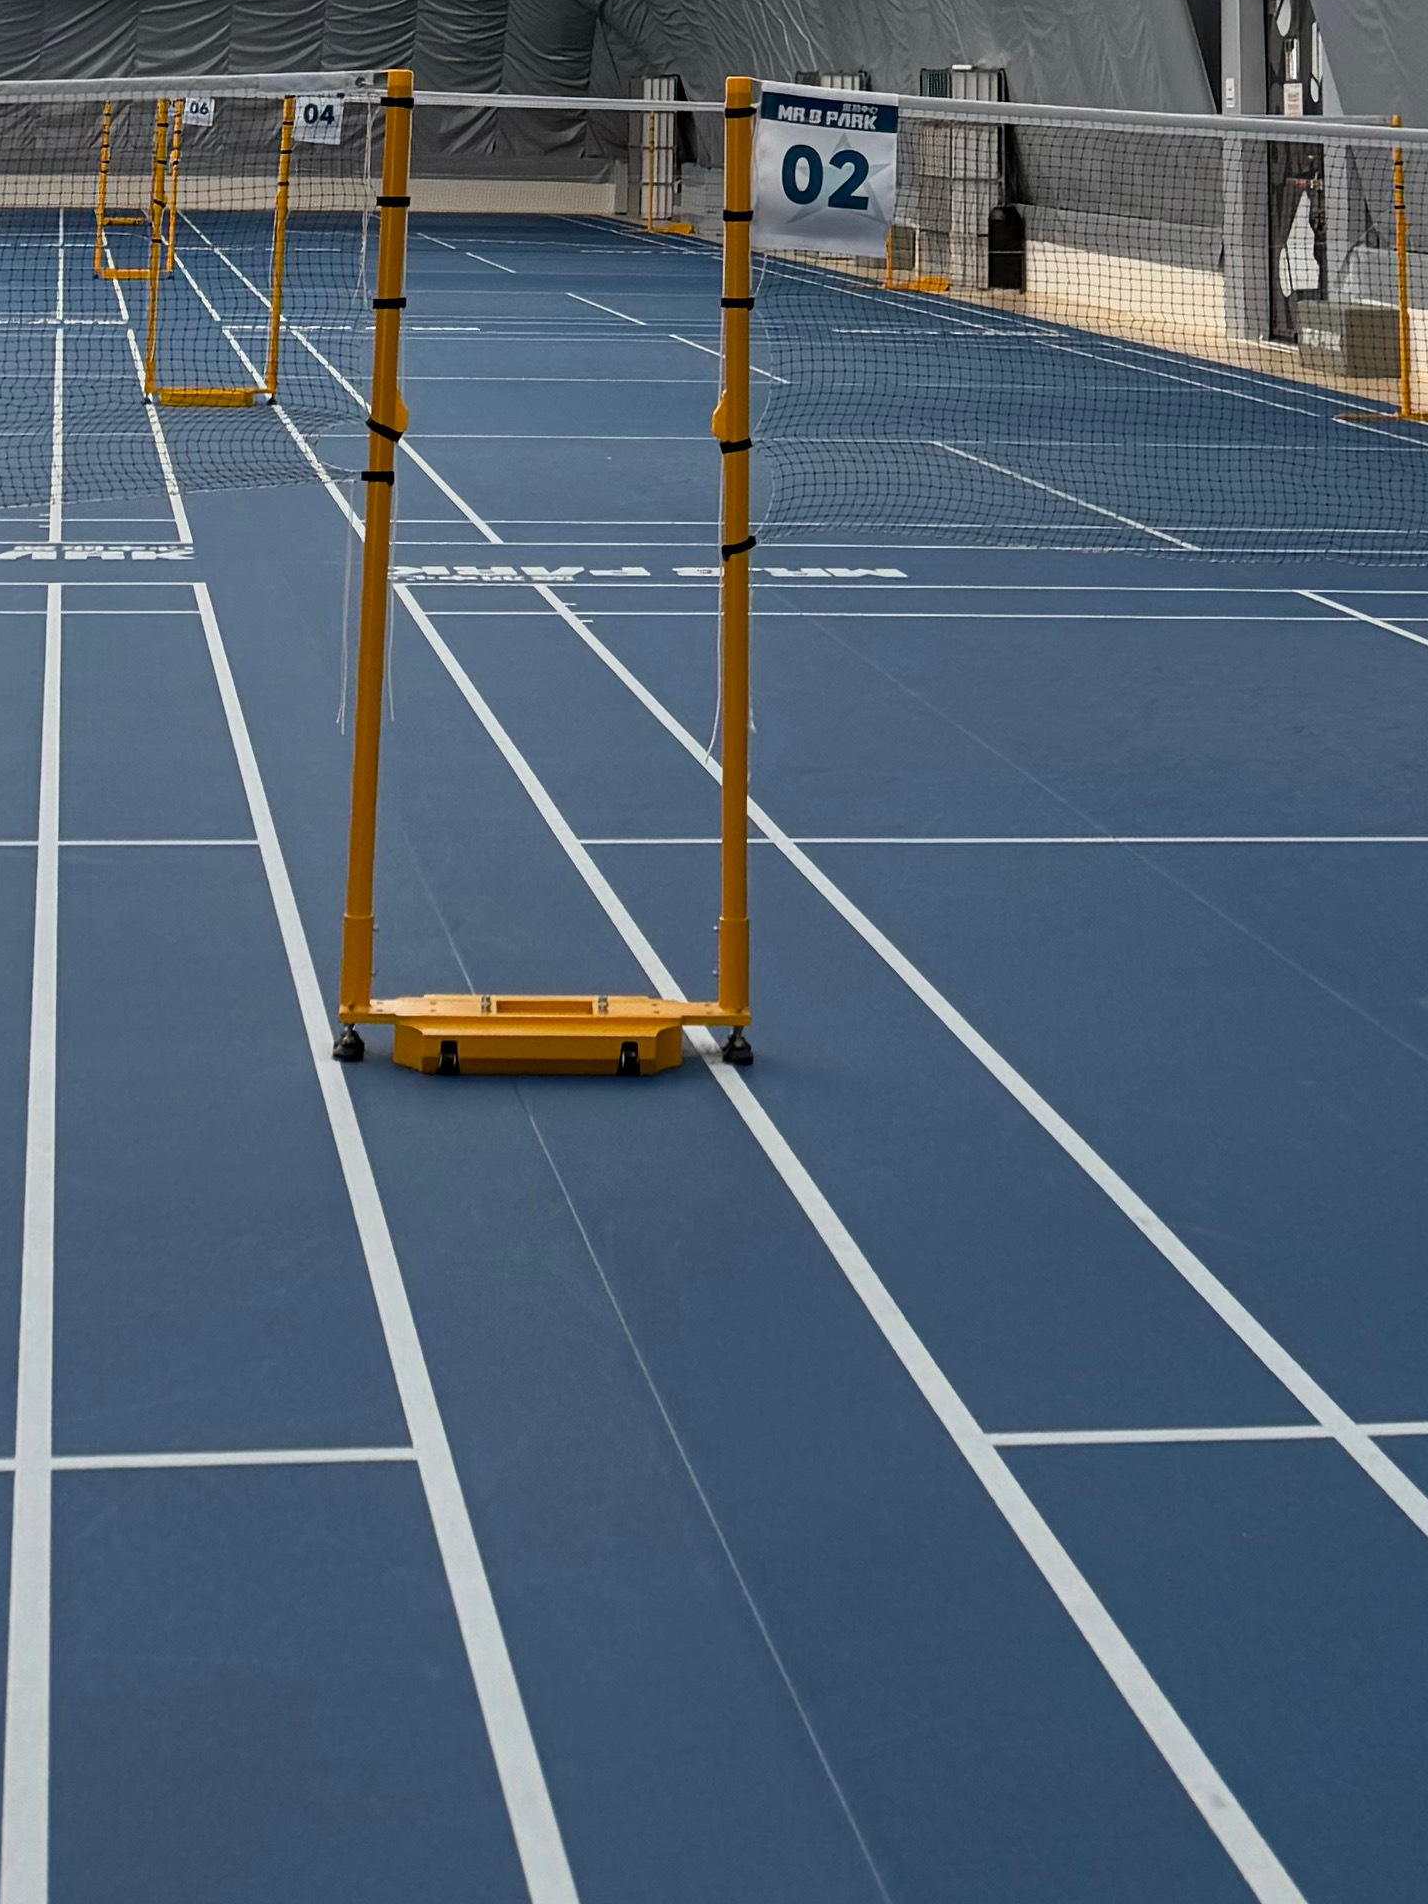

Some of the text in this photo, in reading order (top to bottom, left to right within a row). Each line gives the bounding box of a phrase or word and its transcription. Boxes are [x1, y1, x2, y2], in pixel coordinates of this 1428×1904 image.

[189, 100, 210, 116] 06
[303, 103, 336, 126] 04
[825, 110, 878, 130] PARK
[781, 144, 869, 210] 02
